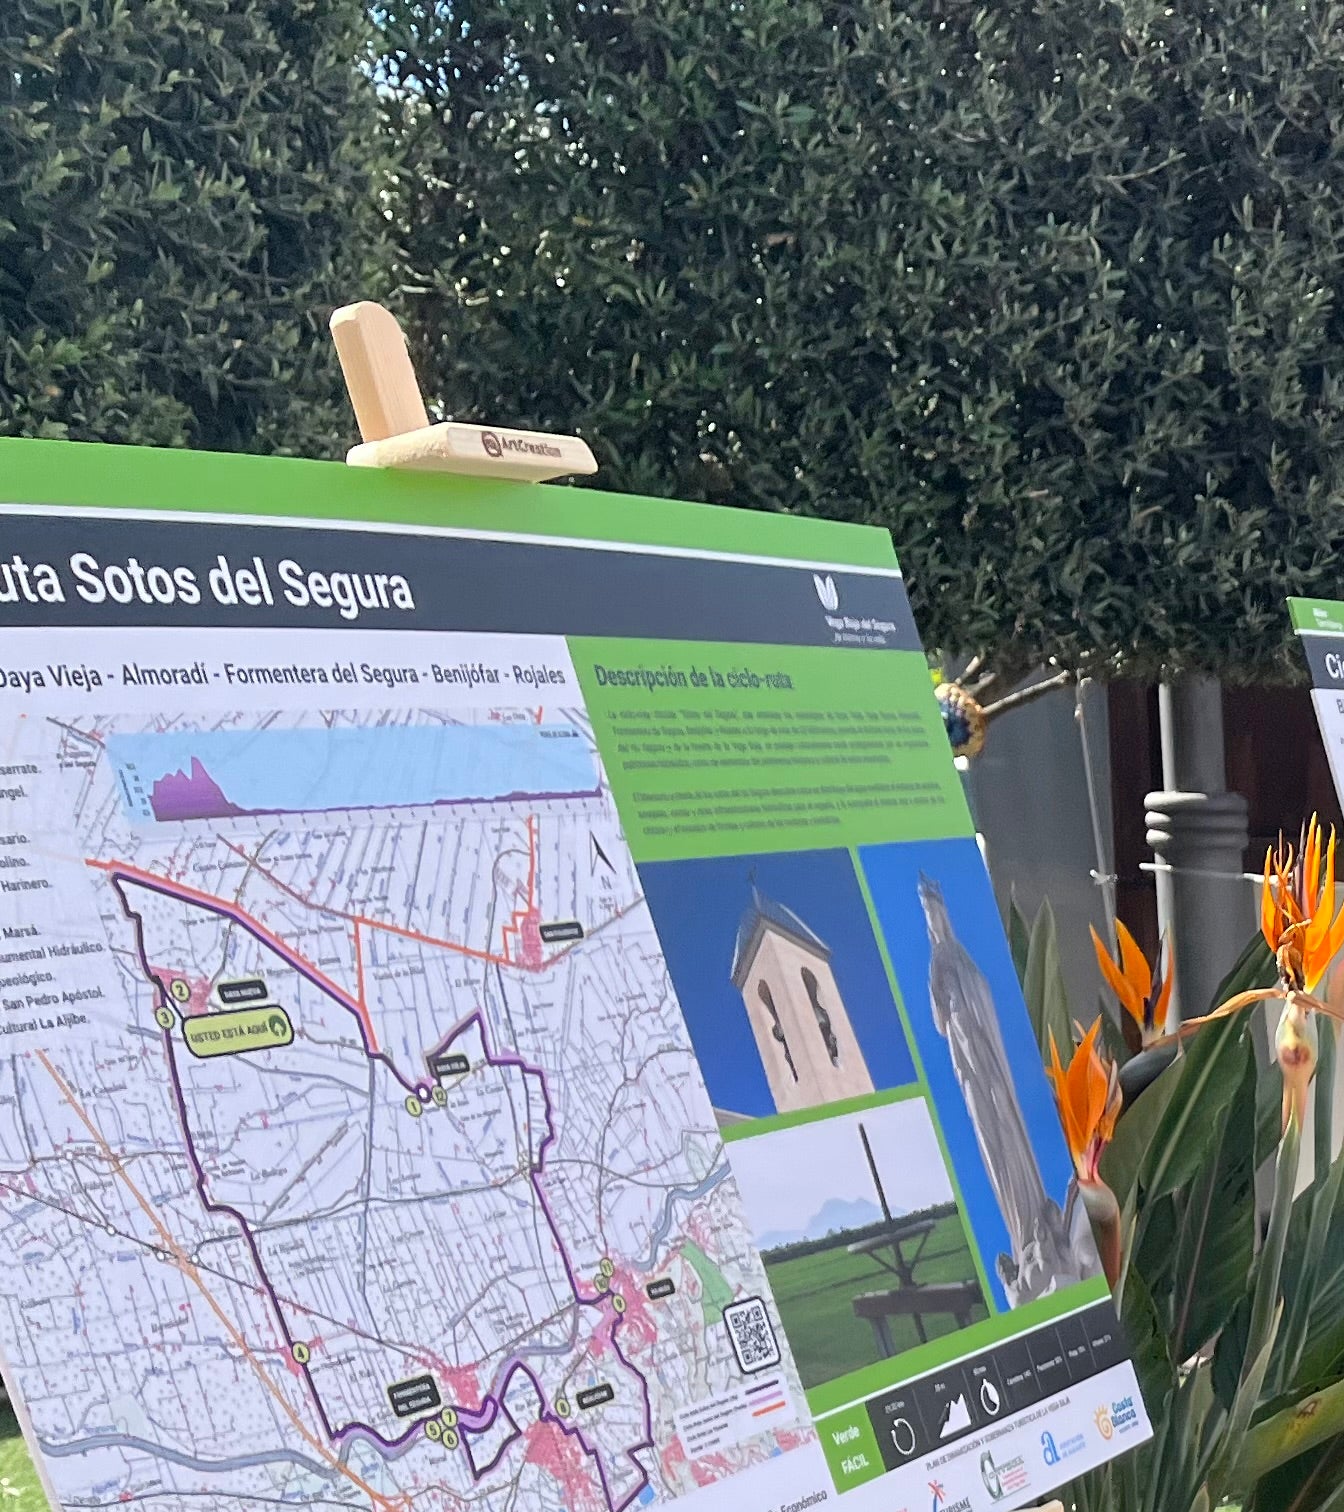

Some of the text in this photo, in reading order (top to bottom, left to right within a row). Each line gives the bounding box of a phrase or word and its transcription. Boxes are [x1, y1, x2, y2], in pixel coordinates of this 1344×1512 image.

[69, 552, 201, 605] Sotos
[208, 555, 274, 606] del
[277, 558, 416, 620] Segura
[47, 664, 103, 692] Vieja
[122, 661, 209, 686] Almoradí
[224, 663, 329, 684] Formentera
[332, 662, 358, 683] del
[360, 662, 419, 687] Segura
[431, 663, 500, 688] Benijófar
[512, 664, 566, 688] Rojales
[594, 664, 688, 692] Descripción
[689, 665, 709, 688] de
[709, 665, 726, 688] la
[39, 1018, 54, 1029] La
[190, 1030, 221, 1044] USTED
[222, 1026, 246, 1040] ESTÁ
[832, 1425, 860, 1446] Verde
[841, 1453, 869, 1475] FÁCIL
